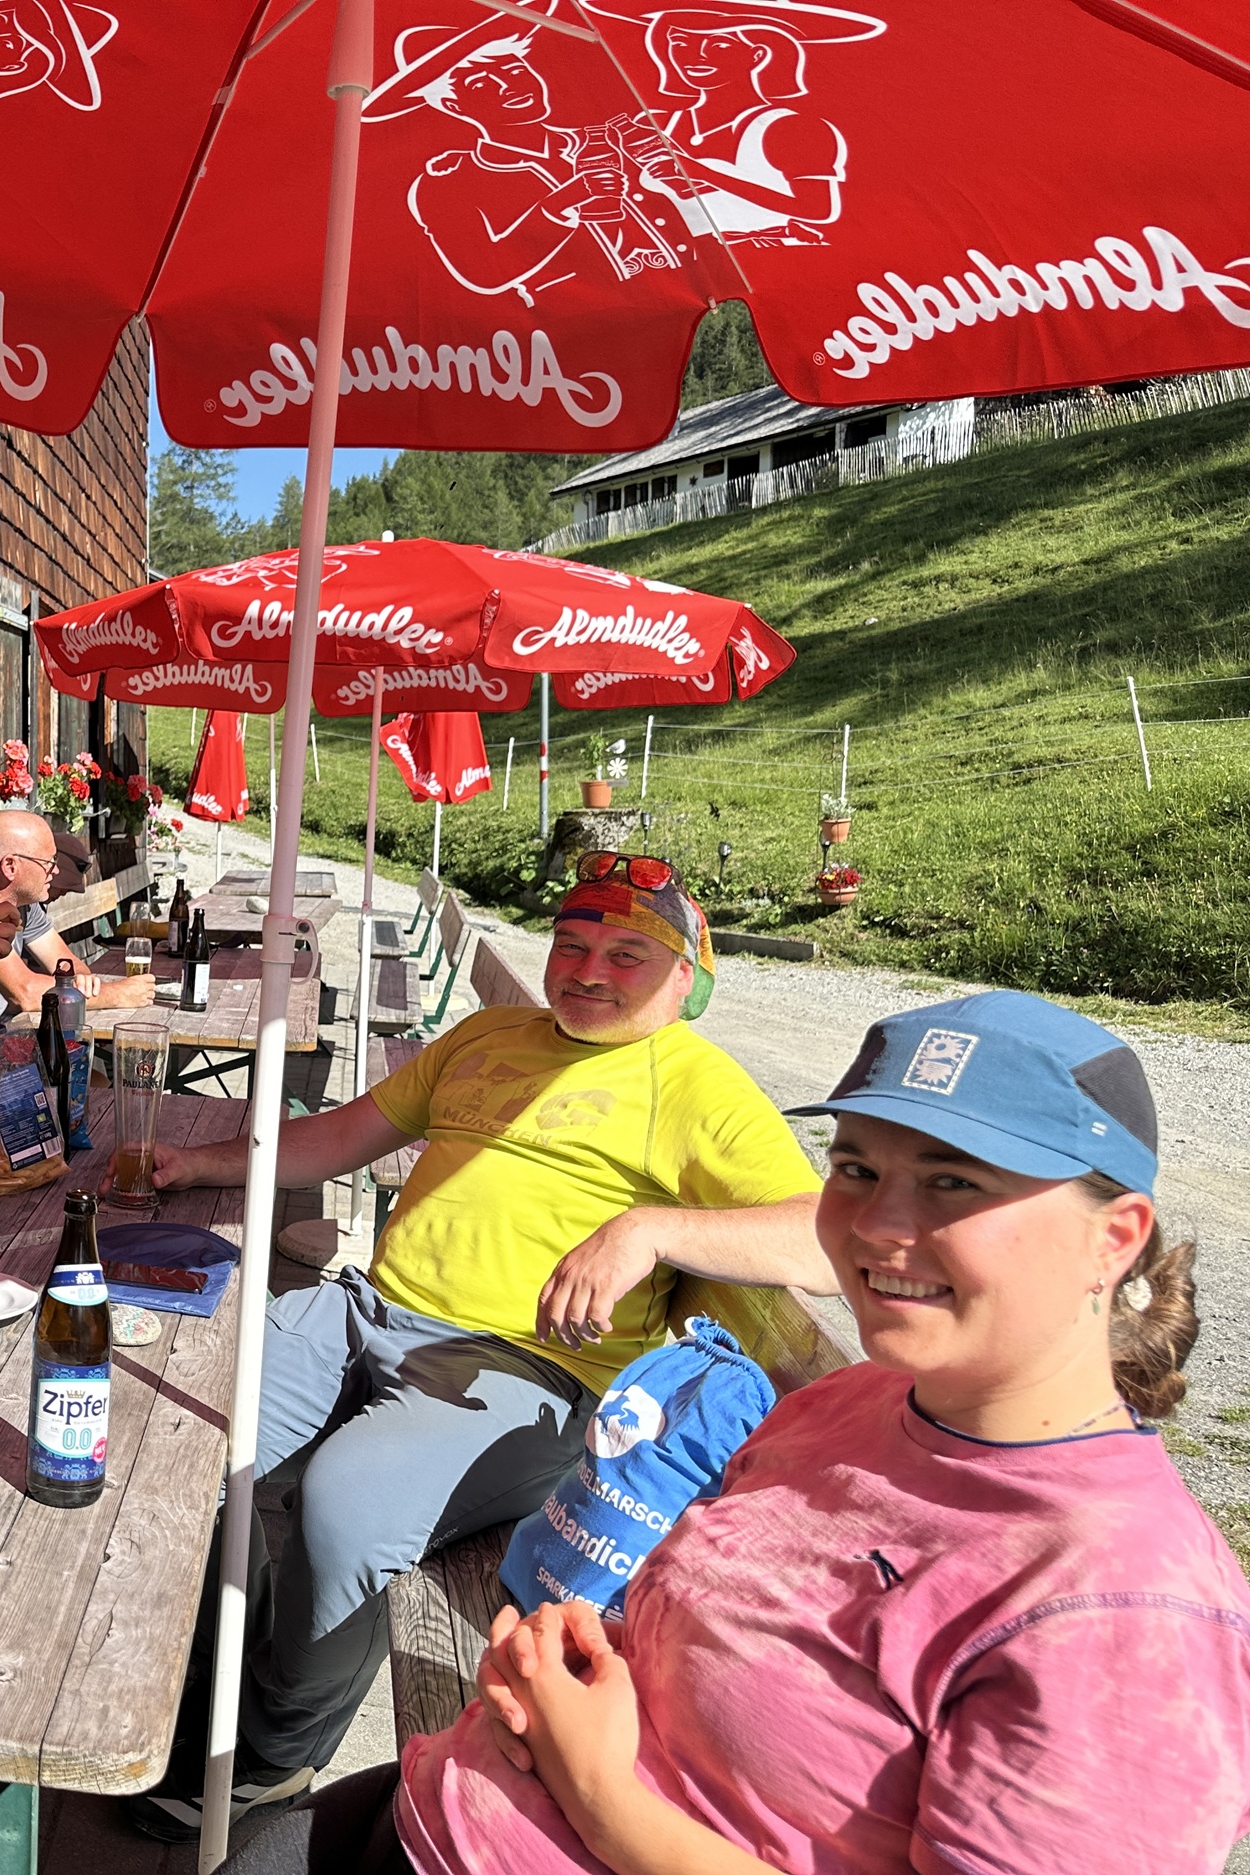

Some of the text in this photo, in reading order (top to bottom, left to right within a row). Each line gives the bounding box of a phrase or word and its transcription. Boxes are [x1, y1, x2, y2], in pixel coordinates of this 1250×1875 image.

[58, 609, 160, 664] Almdudler
[513, 605, 702, 665] Almdudler
[443, 1105, 552, 1146] MÜNCHEN
[42, 1388, 108, 1425] Zipfer
[62, 1427, 92, 1451] 0.0
